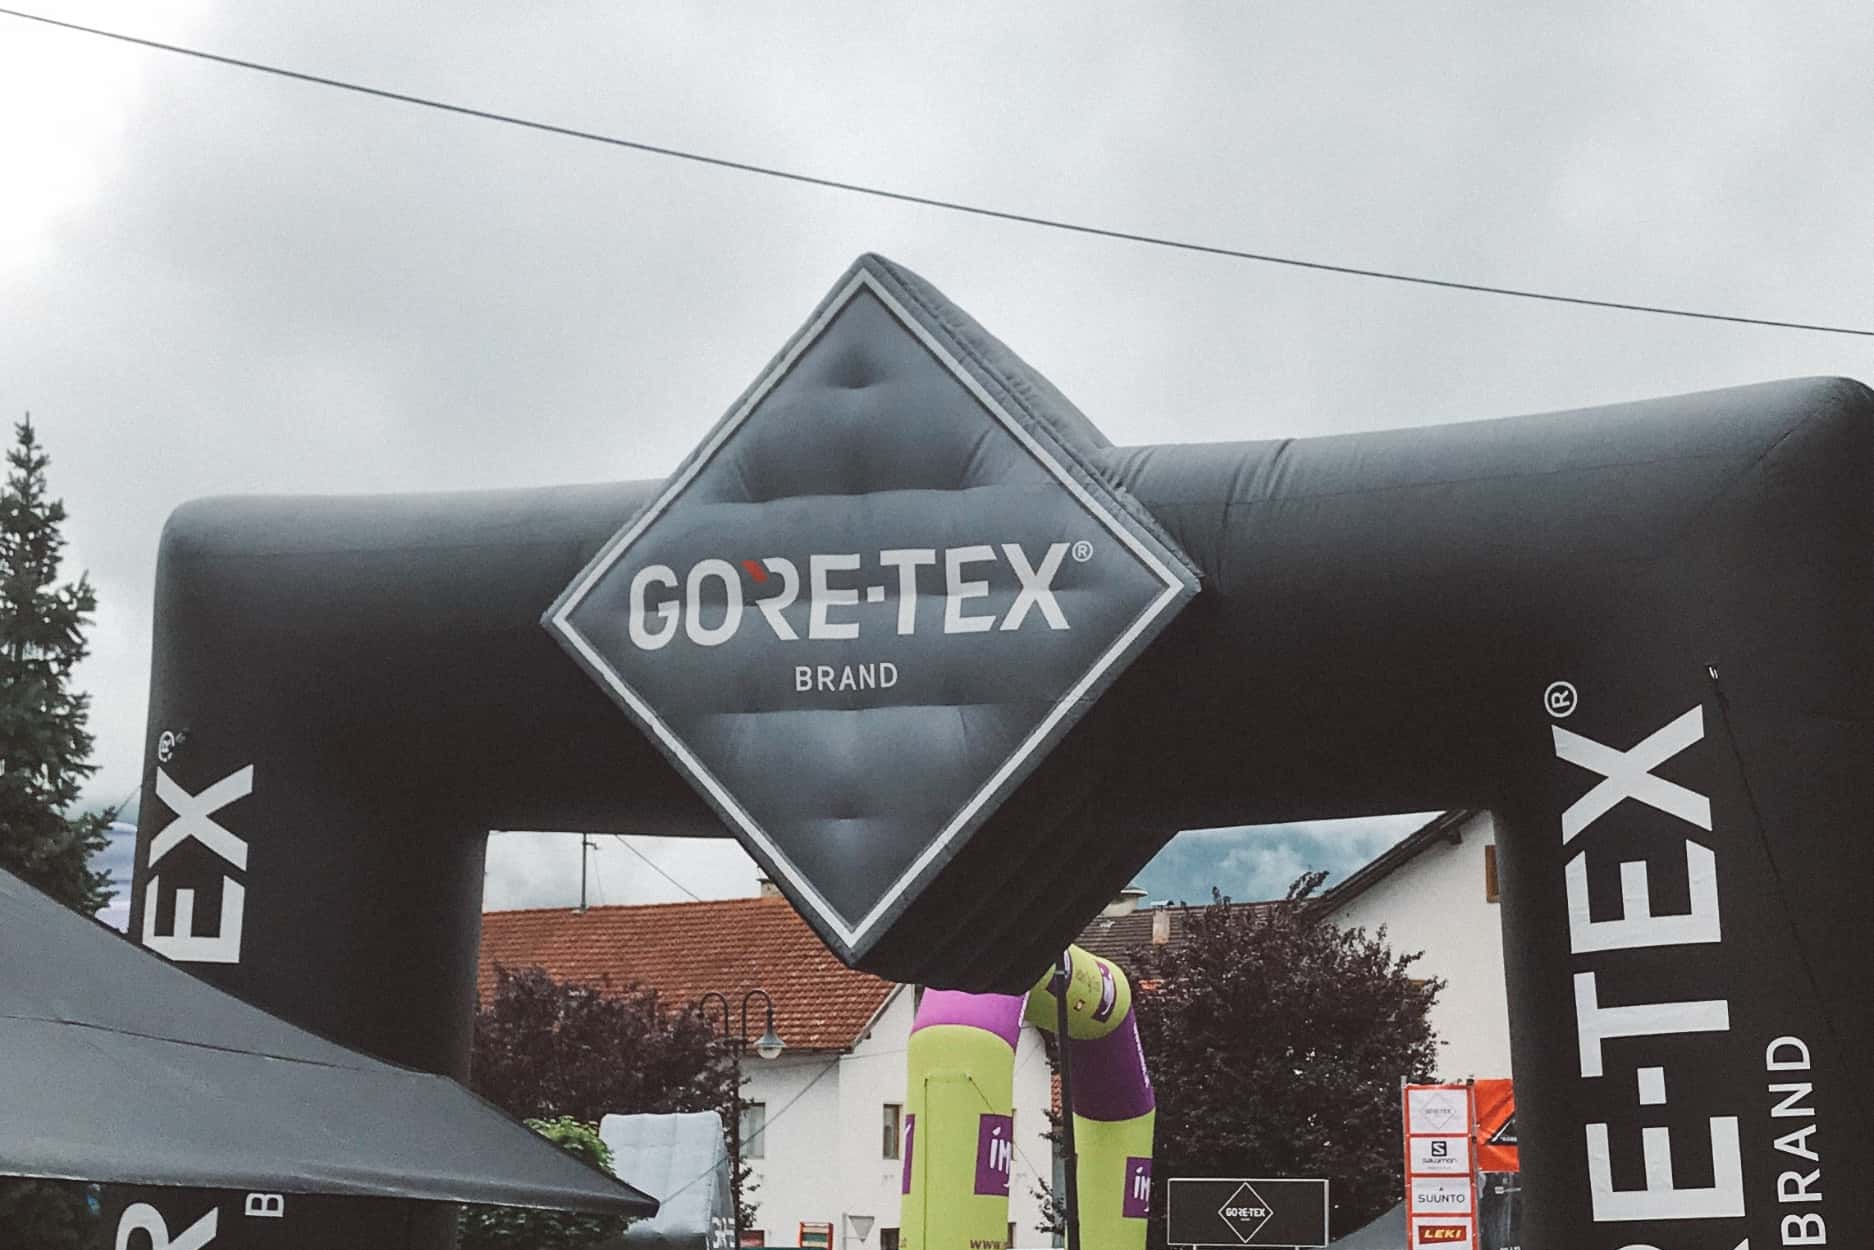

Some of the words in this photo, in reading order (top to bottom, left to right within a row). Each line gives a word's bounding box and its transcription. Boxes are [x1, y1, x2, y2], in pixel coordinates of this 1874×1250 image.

[795, 662, 898, 691] BRAND
[1766, 1036, 1827, 1246] BRAND
[1418, 1193, 1465, 1204] SUUNTO
[1225, 1207, 1266, 1217] GORE-TEX
[1424, 1229, 1462, 1239] LEKI
